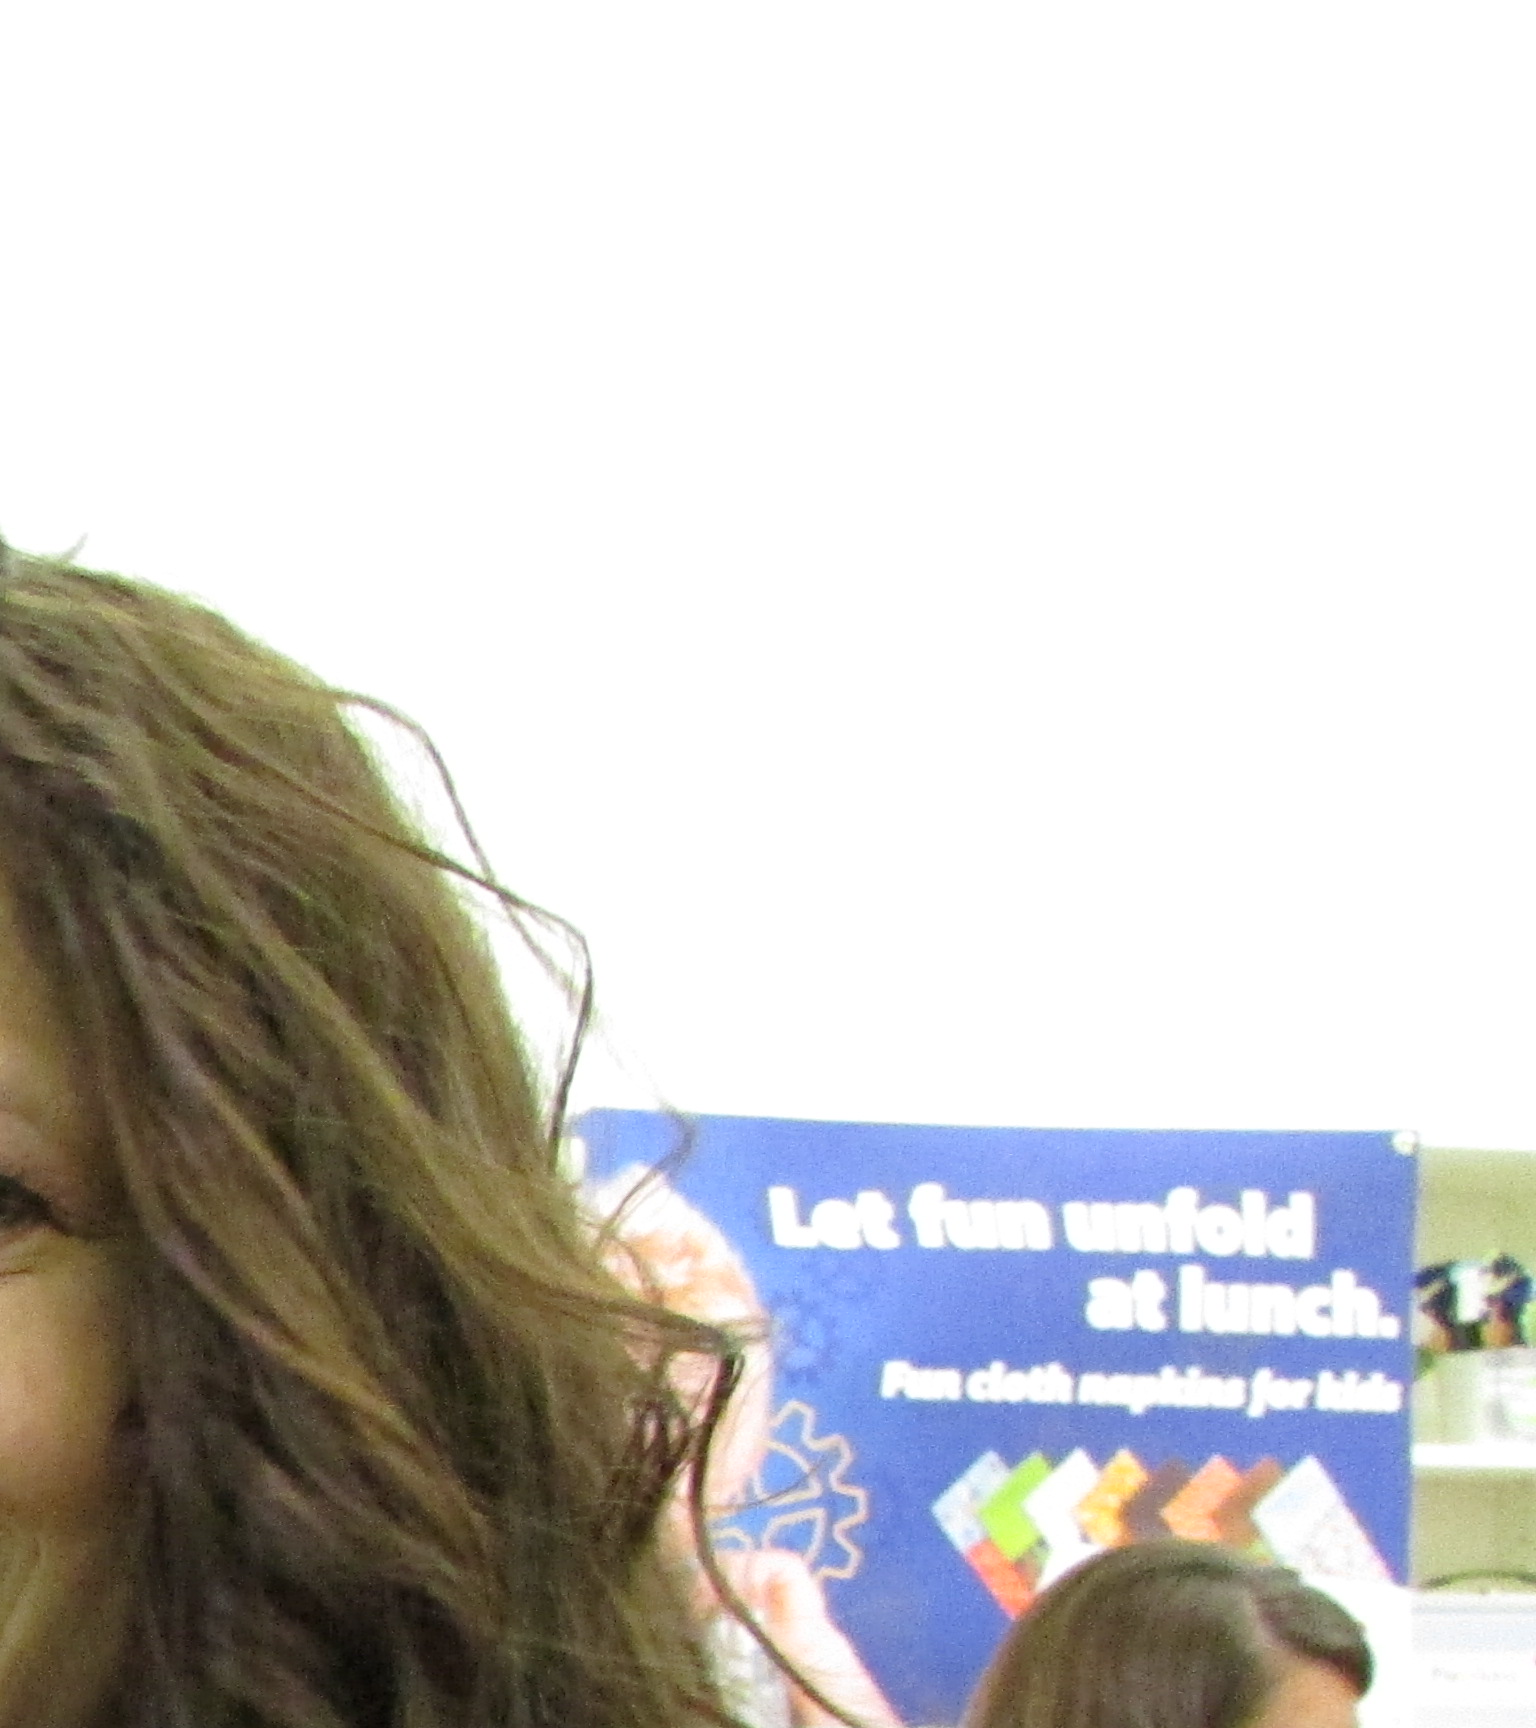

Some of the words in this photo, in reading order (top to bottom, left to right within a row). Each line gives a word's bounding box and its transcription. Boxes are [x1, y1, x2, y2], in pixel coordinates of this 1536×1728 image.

[767, 1184, 901, 1251] Let
[909, 1180, 1053, 1252] fun
[1062, 1185, 1317, 1260] unfold
[1083, 1268, 1168, 1333] at
[1177, 1263, 1402, 1340] lunch.
[879, 1359, 962, 1402] Fun
[966, 1359, 1074, 1405] cloth
[1078, 1364, 1248, 1416] napkins
[1246, 1366, 1314, 1419] for
[1315, 1370, 1404, 1414] kids
